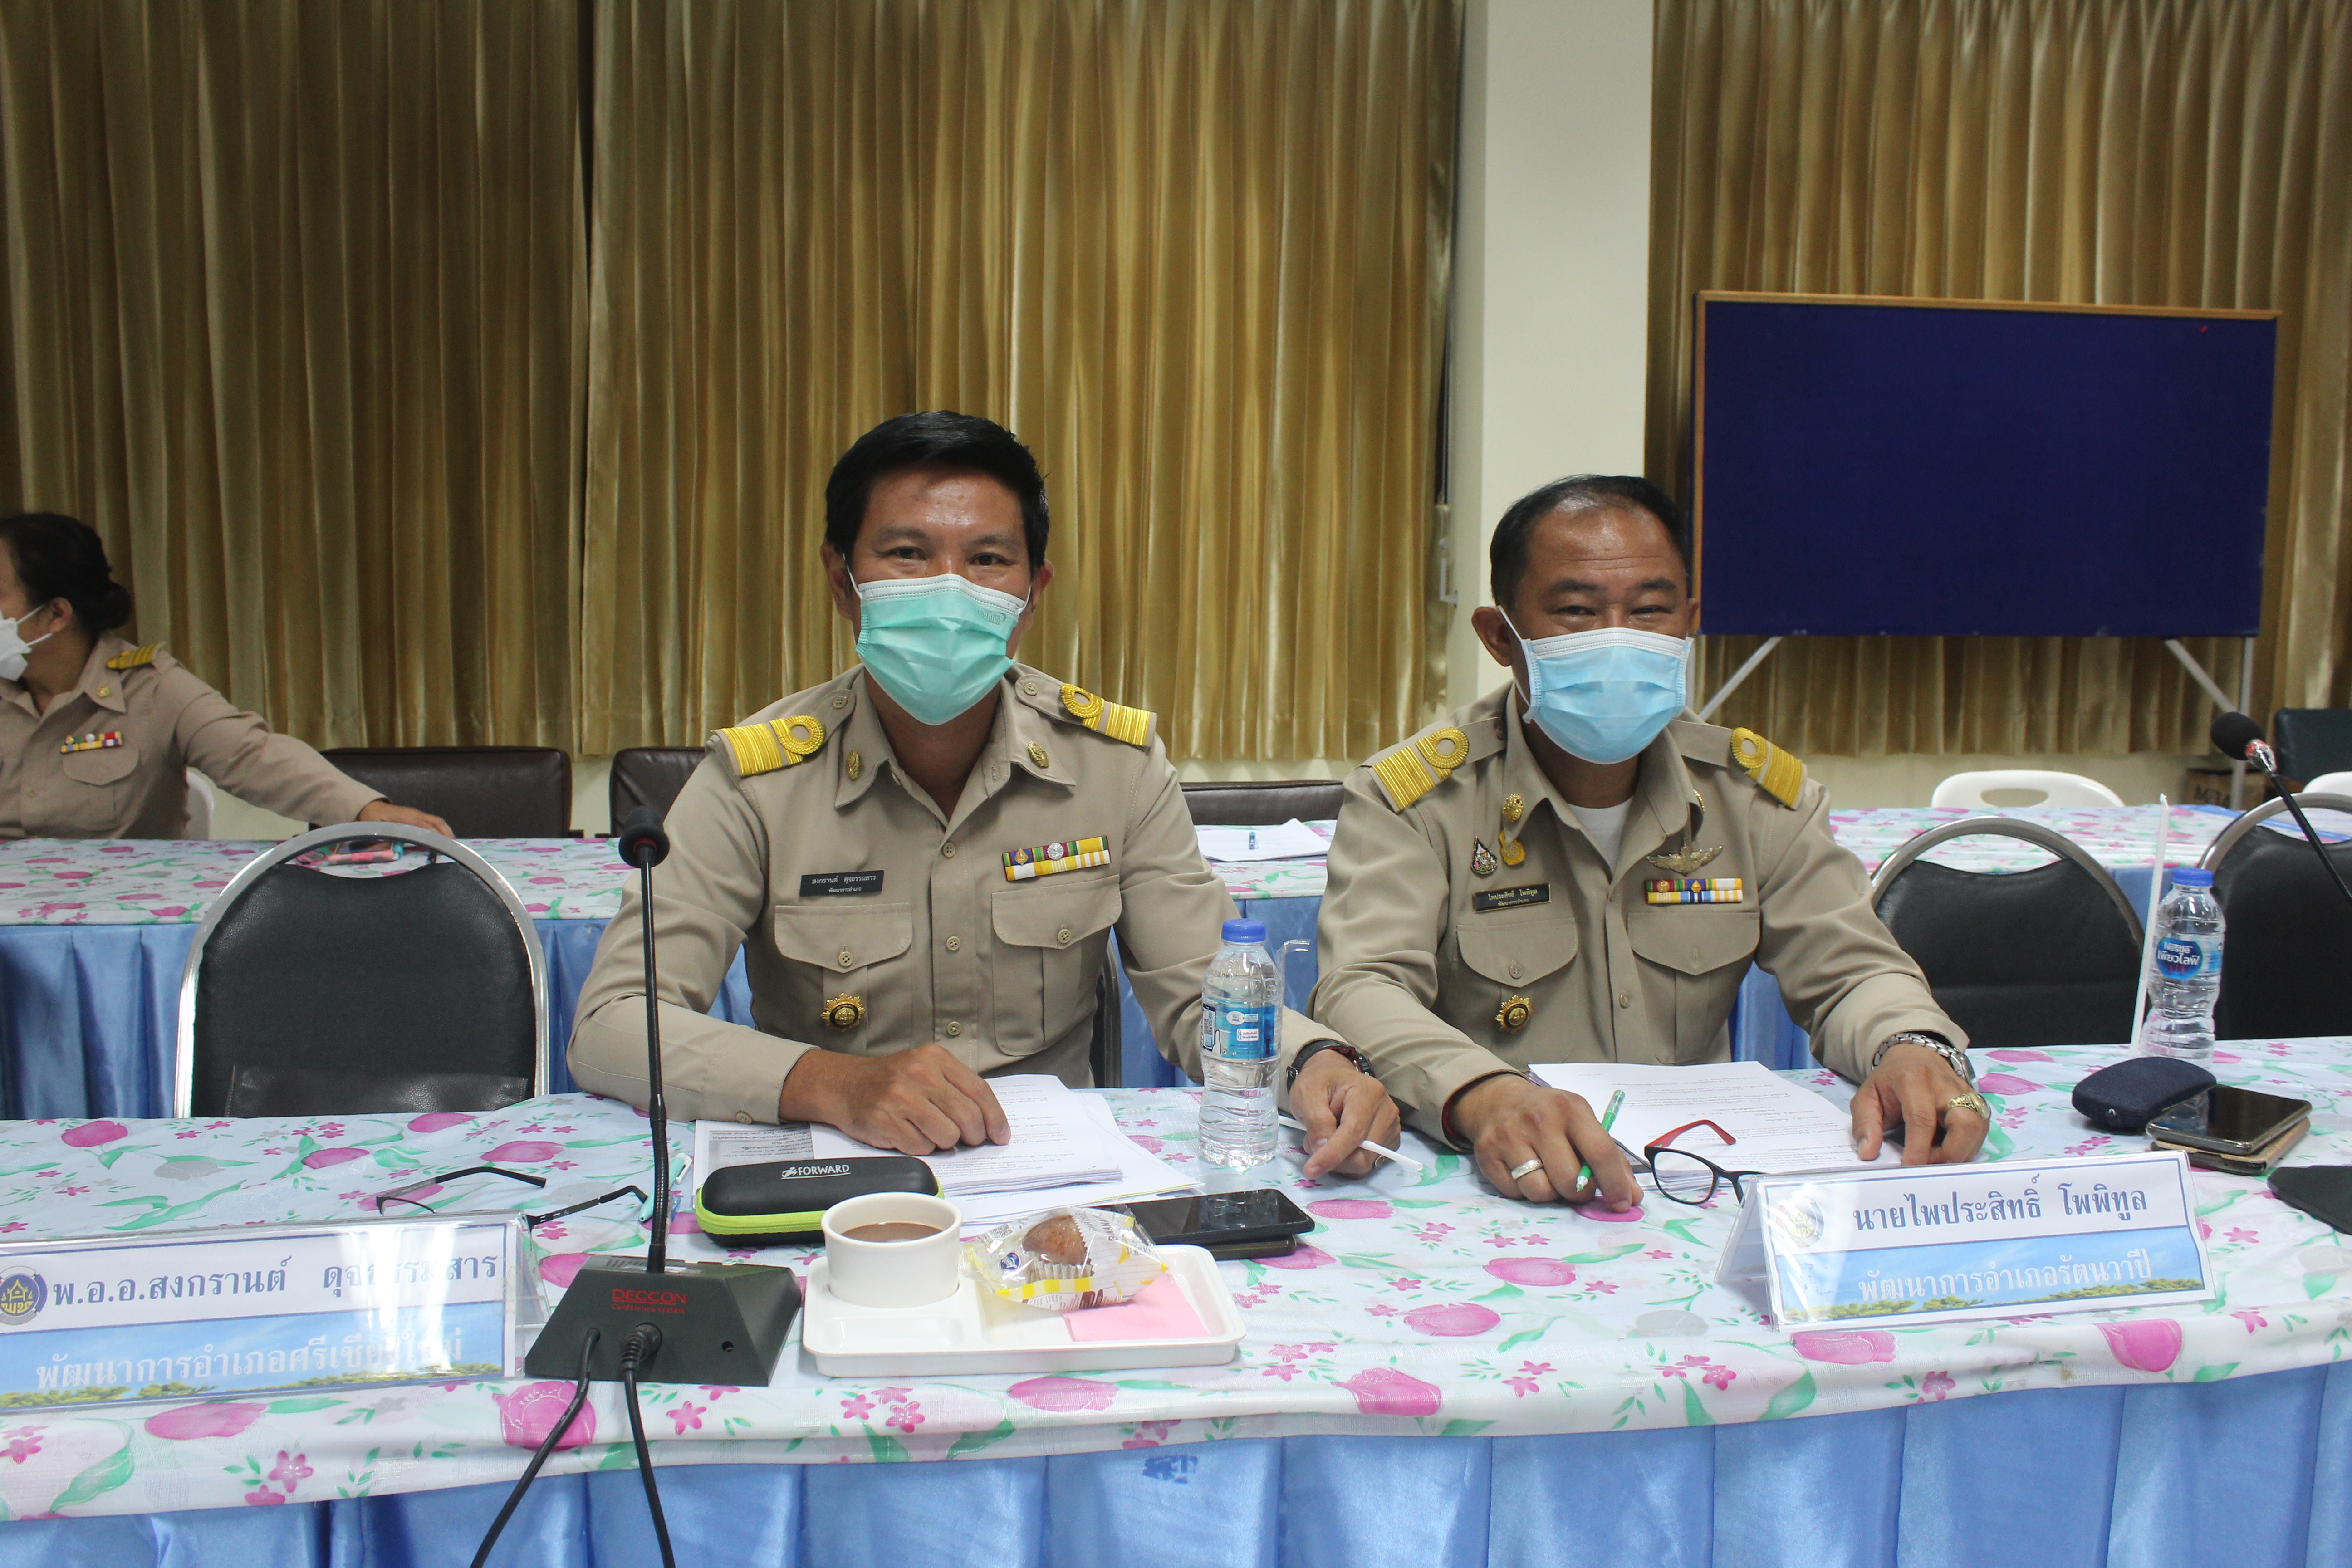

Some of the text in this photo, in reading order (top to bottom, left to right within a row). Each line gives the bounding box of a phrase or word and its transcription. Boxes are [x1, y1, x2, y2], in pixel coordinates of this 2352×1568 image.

[798, 1164, 850, 1176] FORWARD
[1853, 1173, 2147, 1230] นายไพประสิทธิ์ โพพิทูล
[53, 1255, 292, 1306] พ.อ.อ.สงกรานต์
[612, 1289, 687, 1303] DECCON
[1858, 1247, 2152, 1301] พัฒนาการอำเภอรัตนวาปี
